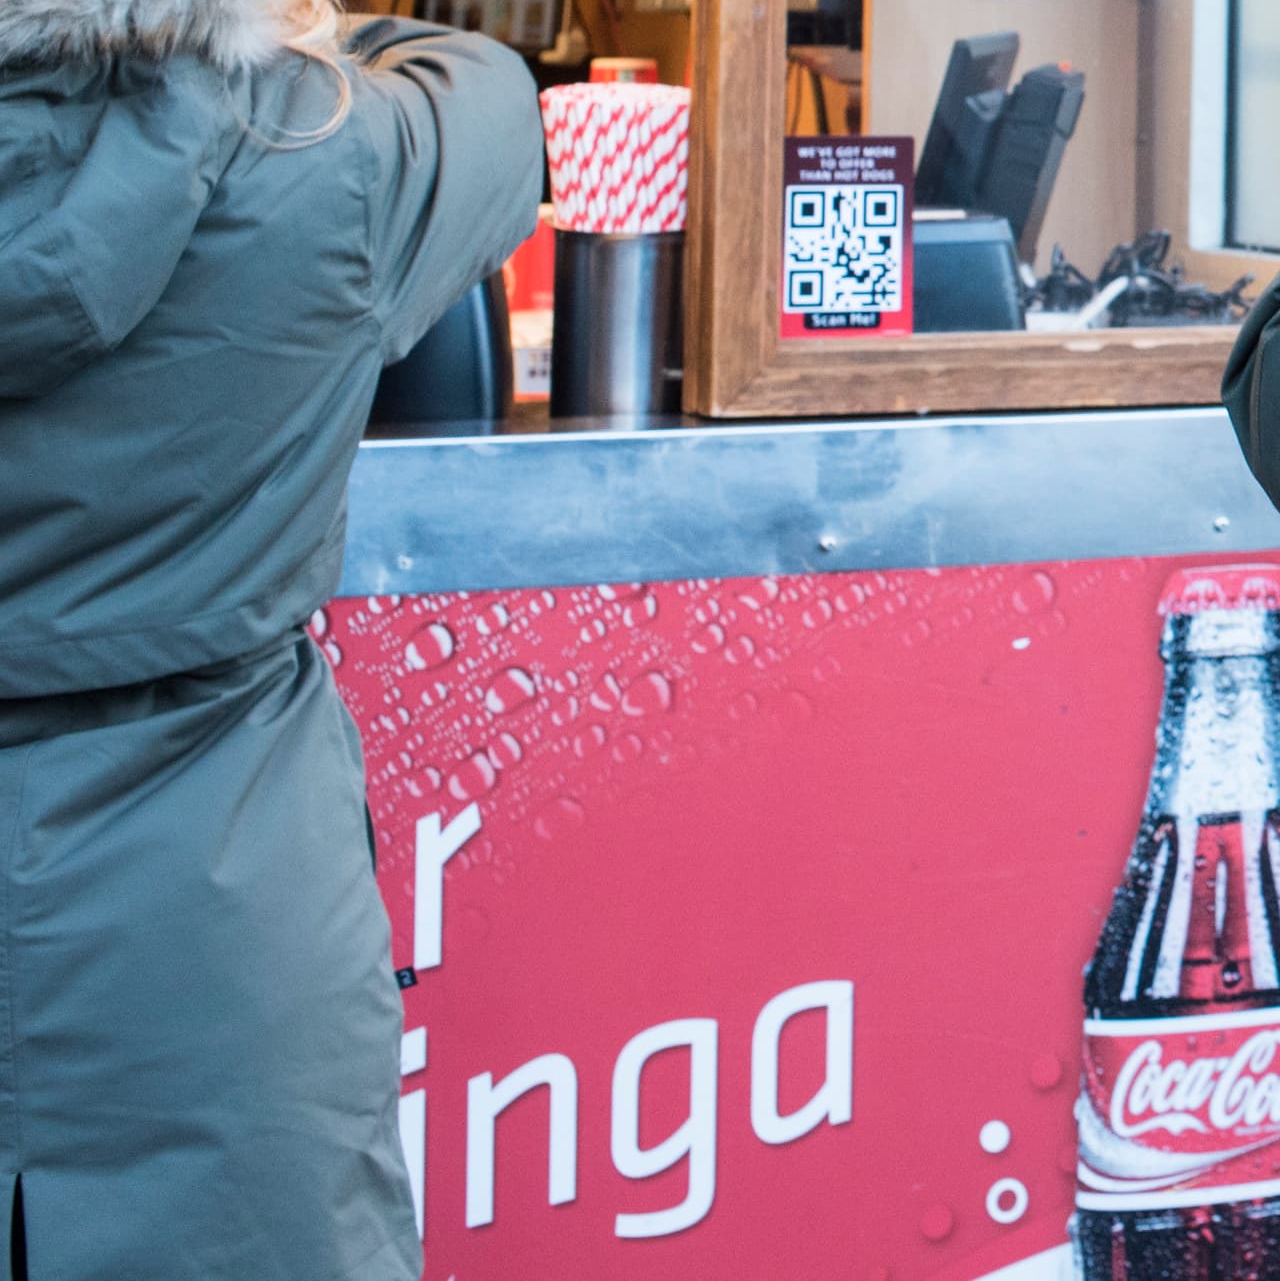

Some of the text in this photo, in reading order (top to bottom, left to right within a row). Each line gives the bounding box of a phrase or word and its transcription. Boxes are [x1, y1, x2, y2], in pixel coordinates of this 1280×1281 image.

[798, 145, 896, 158] WE'VE GOT MORE
[820, 158, 876, 170] TO OFFER
[800, 169, 895, 181] THAN HOT DOGS
[811, 313, 847, 327] Scan
